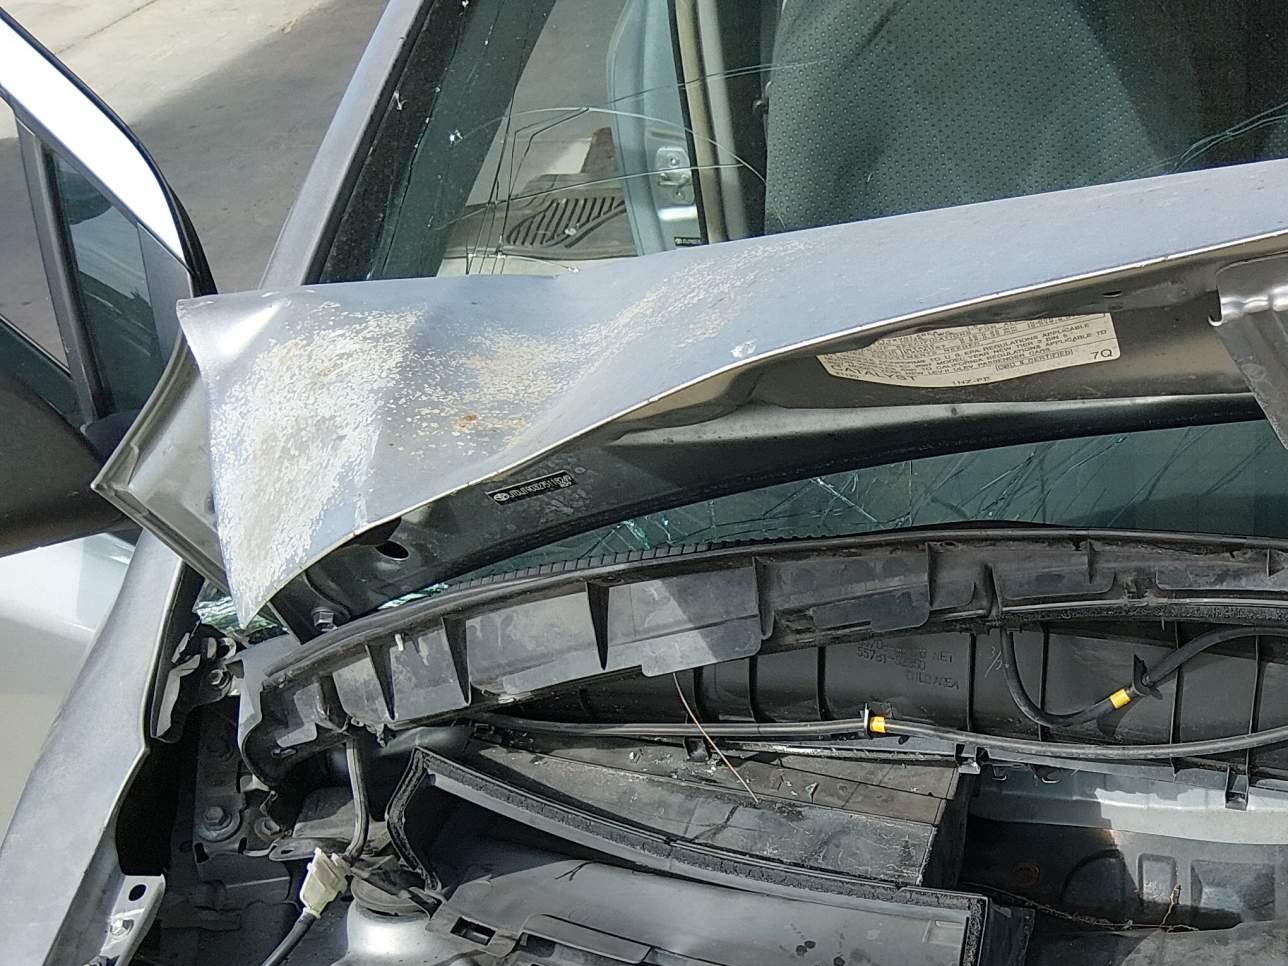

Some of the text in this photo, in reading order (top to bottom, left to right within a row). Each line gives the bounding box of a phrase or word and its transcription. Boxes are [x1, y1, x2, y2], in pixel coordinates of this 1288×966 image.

[1043, 323, 1090, 337] APPLICABLE
[1046, 333, 1092, 346] APPLICABLE
[1090, 348, 1113, 360] 7Q
